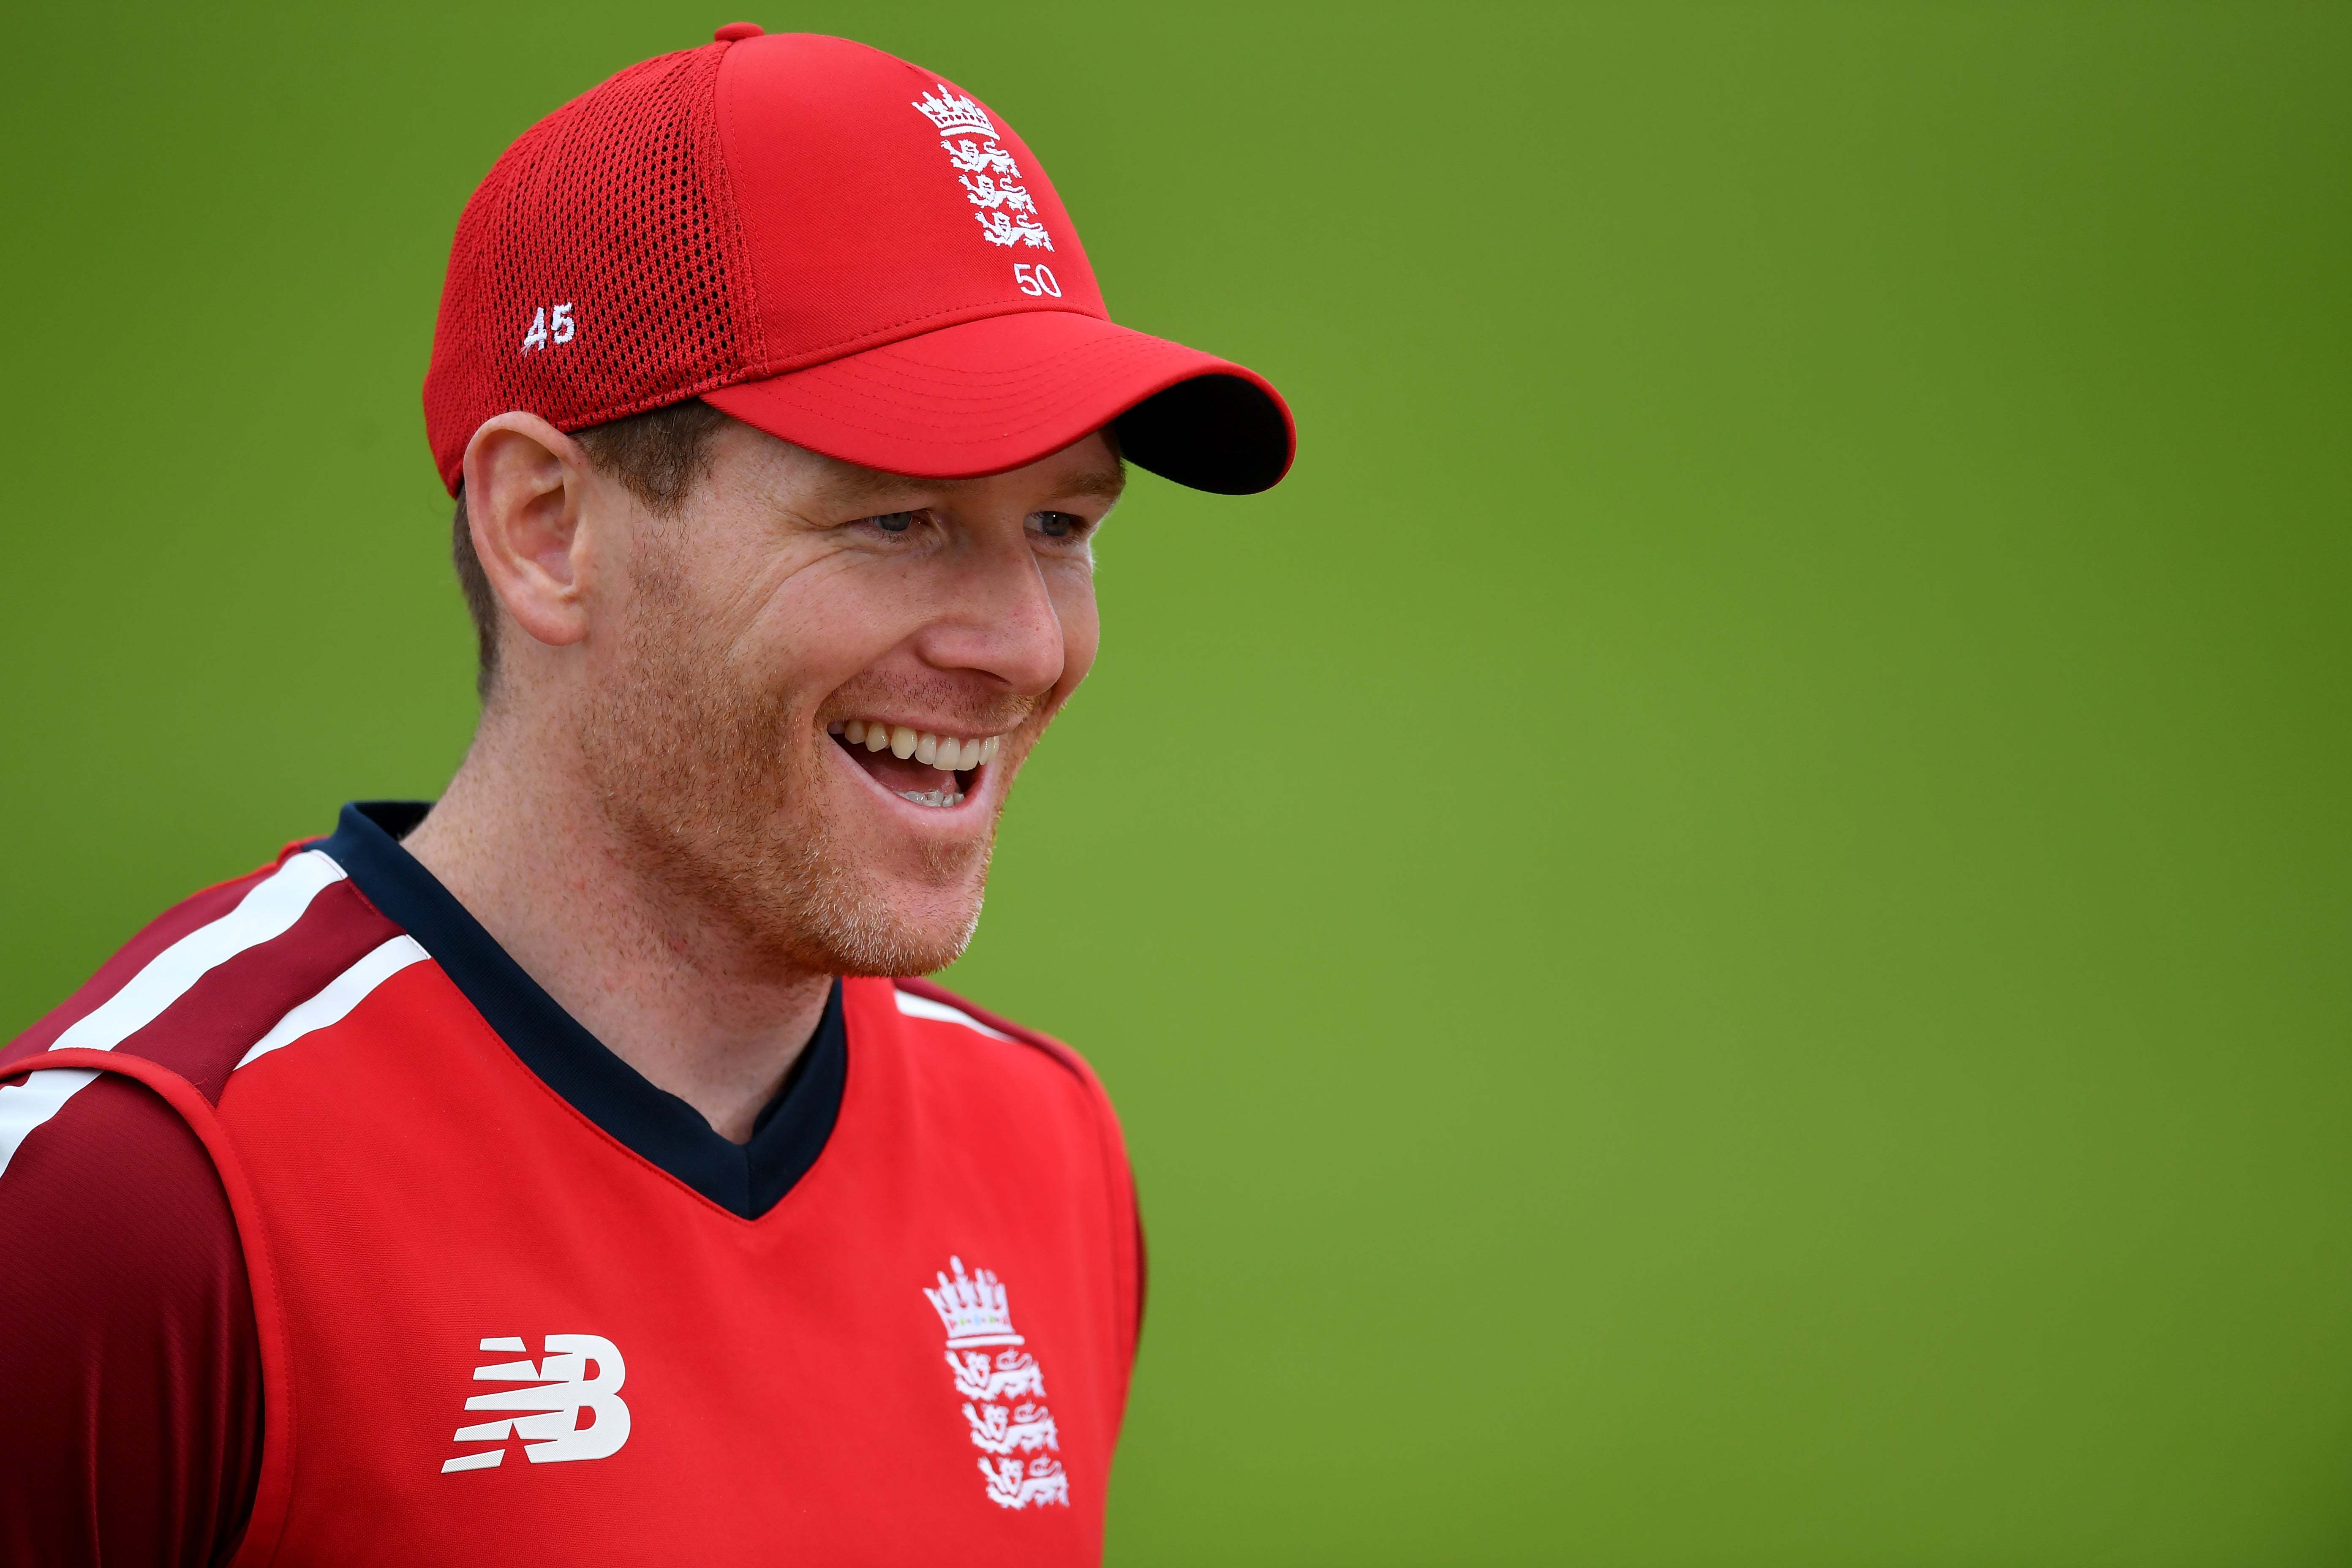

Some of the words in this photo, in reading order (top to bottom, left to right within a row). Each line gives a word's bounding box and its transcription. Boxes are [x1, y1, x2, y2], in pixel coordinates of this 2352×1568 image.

[1013, 263, 1062, 298] 50
[520, 301, 575, 354] 45
[441, 1334, 632, 1474] NB
